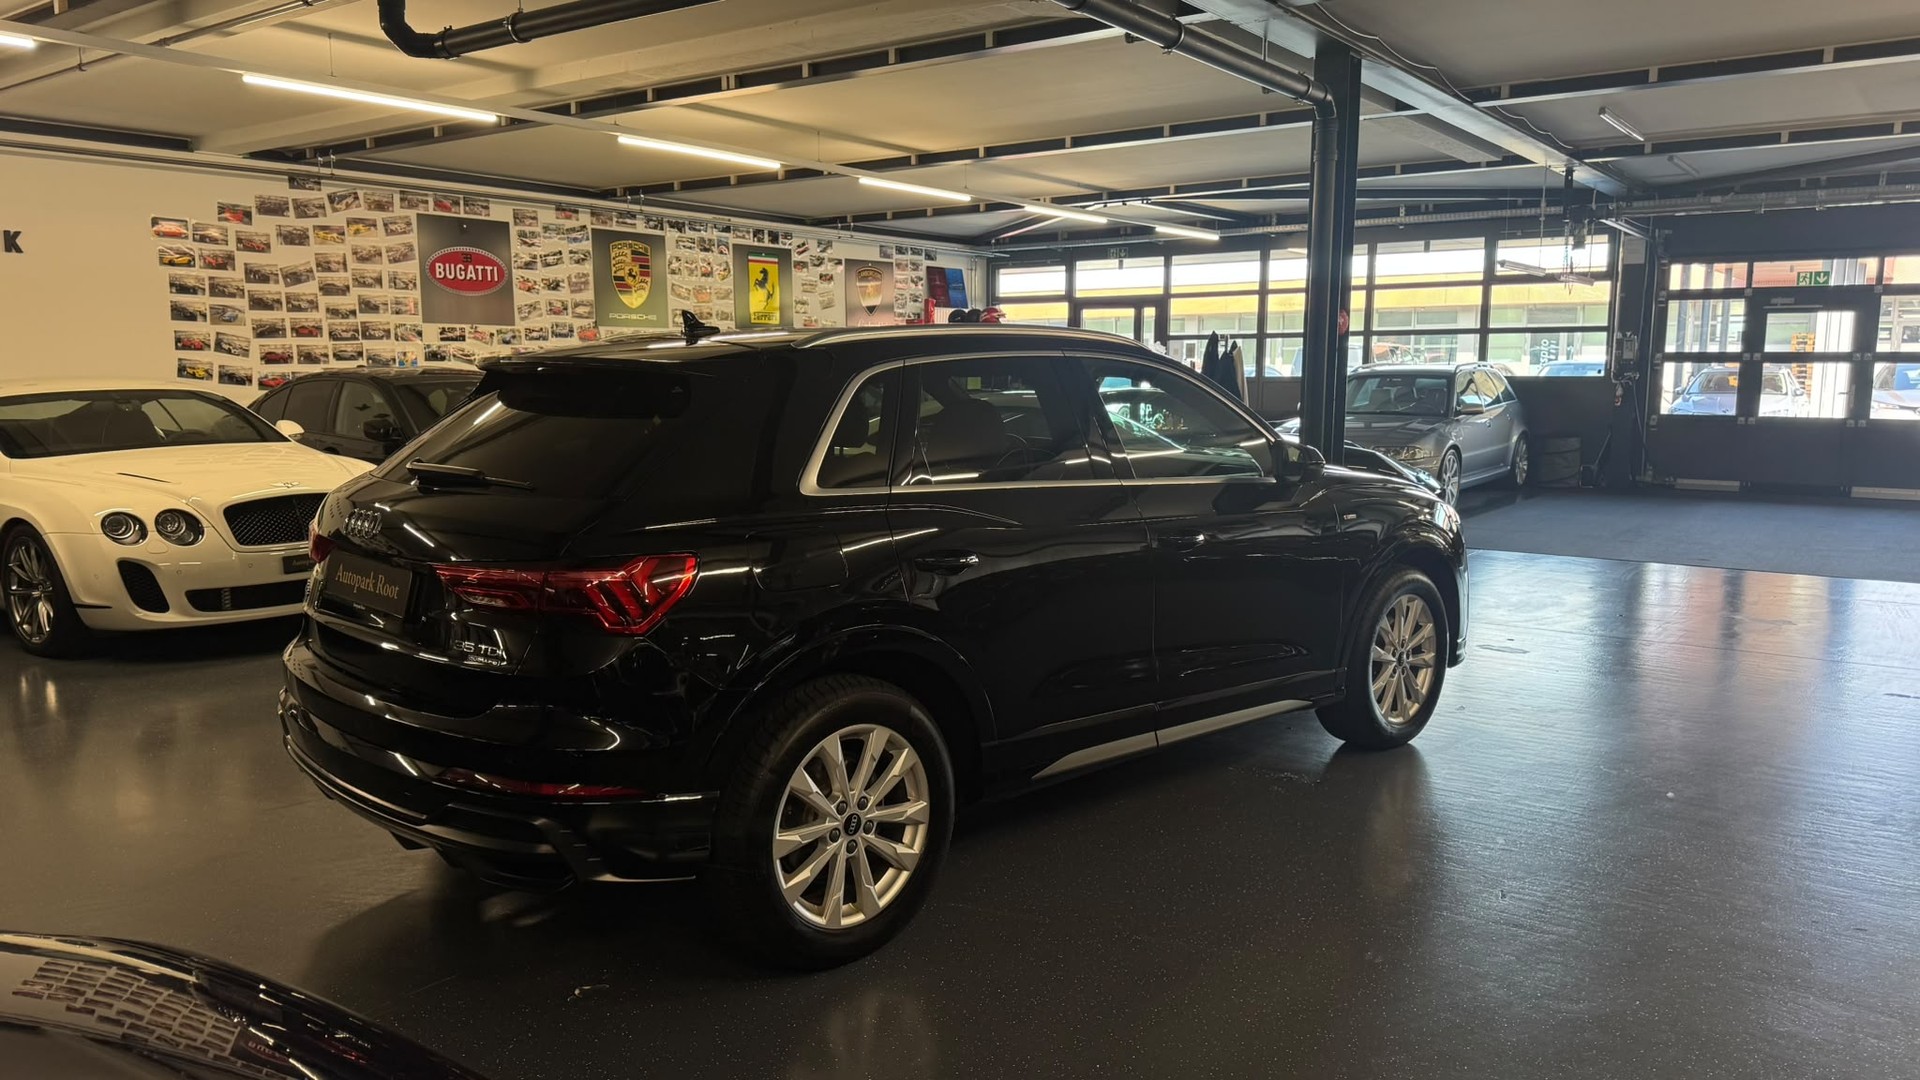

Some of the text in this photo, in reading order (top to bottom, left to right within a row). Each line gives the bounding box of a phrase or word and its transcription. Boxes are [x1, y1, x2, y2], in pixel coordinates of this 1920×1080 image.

[3, 229, 24, 253] K
[435, 262, 498, 282] BUGATTI
[608, 312, 657, 321] PORSCHE
[335, 563, 399, 599] Autopark Root
[454, 640, 475, 653] 35
